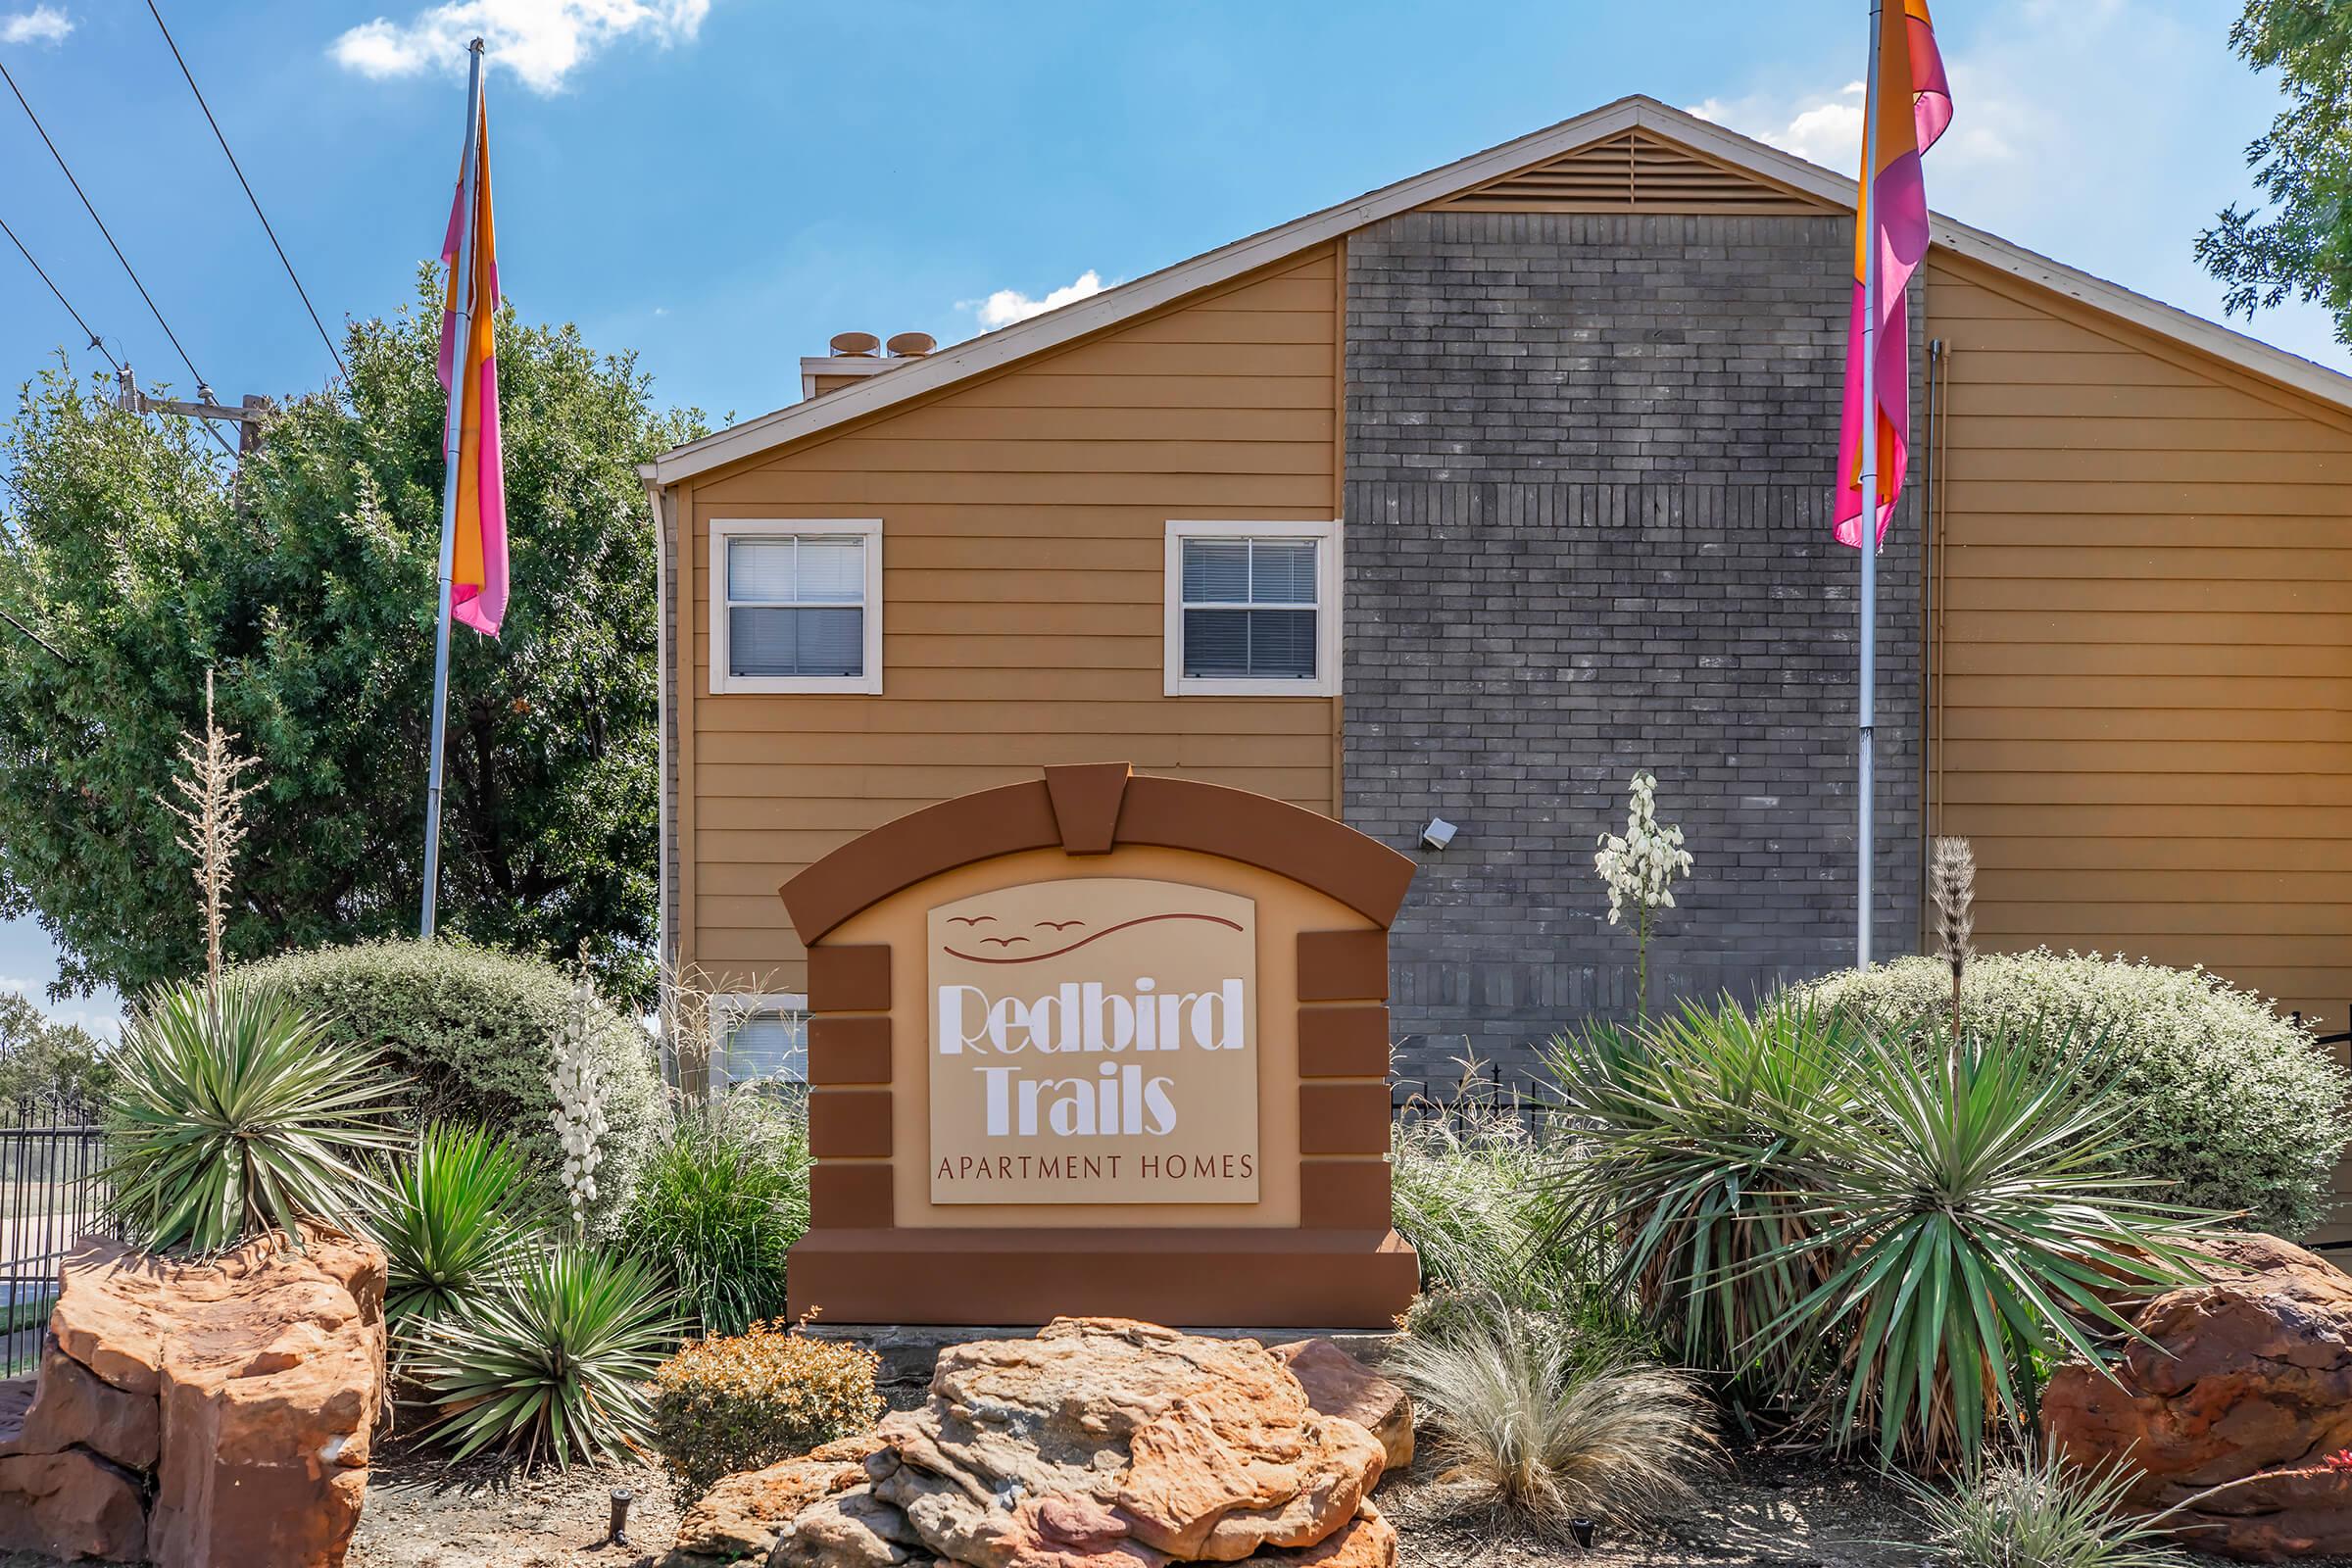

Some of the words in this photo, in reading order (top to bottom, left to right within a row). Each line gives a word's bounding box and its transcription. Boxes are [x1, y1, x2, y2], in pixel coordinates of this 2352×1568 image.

[938, 977, 1244, 1054] Redbird
[972, 1060, 1177, 1137] Trails
[938, 1155, 1122, 1180] APARTMENT
[1141, 1153, 1253, 1179] HOMES
